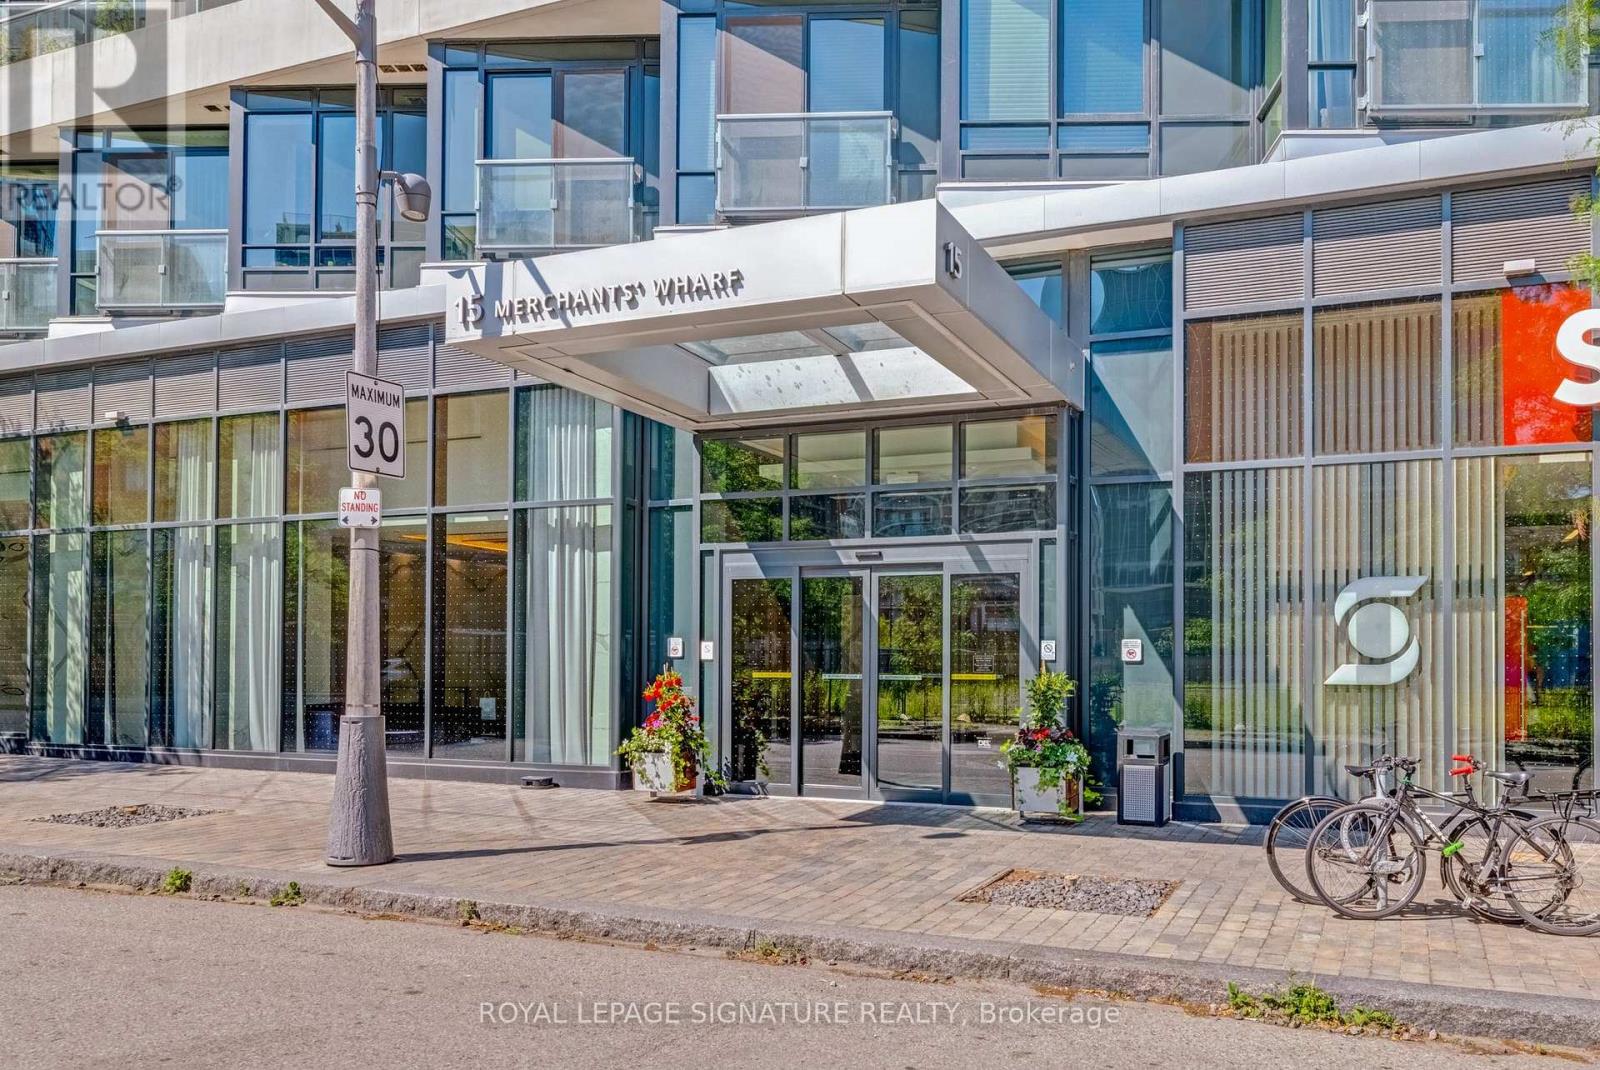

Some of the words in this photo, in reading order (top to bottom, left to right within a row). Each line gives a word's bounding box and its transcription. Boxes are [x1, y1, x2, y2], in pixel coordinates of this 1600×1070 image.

[943, 241, 962, 279] 15
[454, 295, 485, 325] 15
[653, 268, 743, 297] WHARF
[351, 383, 400, 409] MAXIMUM
[354, 415, 399, 463] 30
[341, 502, 379, 513] STANDING
[354, 491, 366, 501] NO
